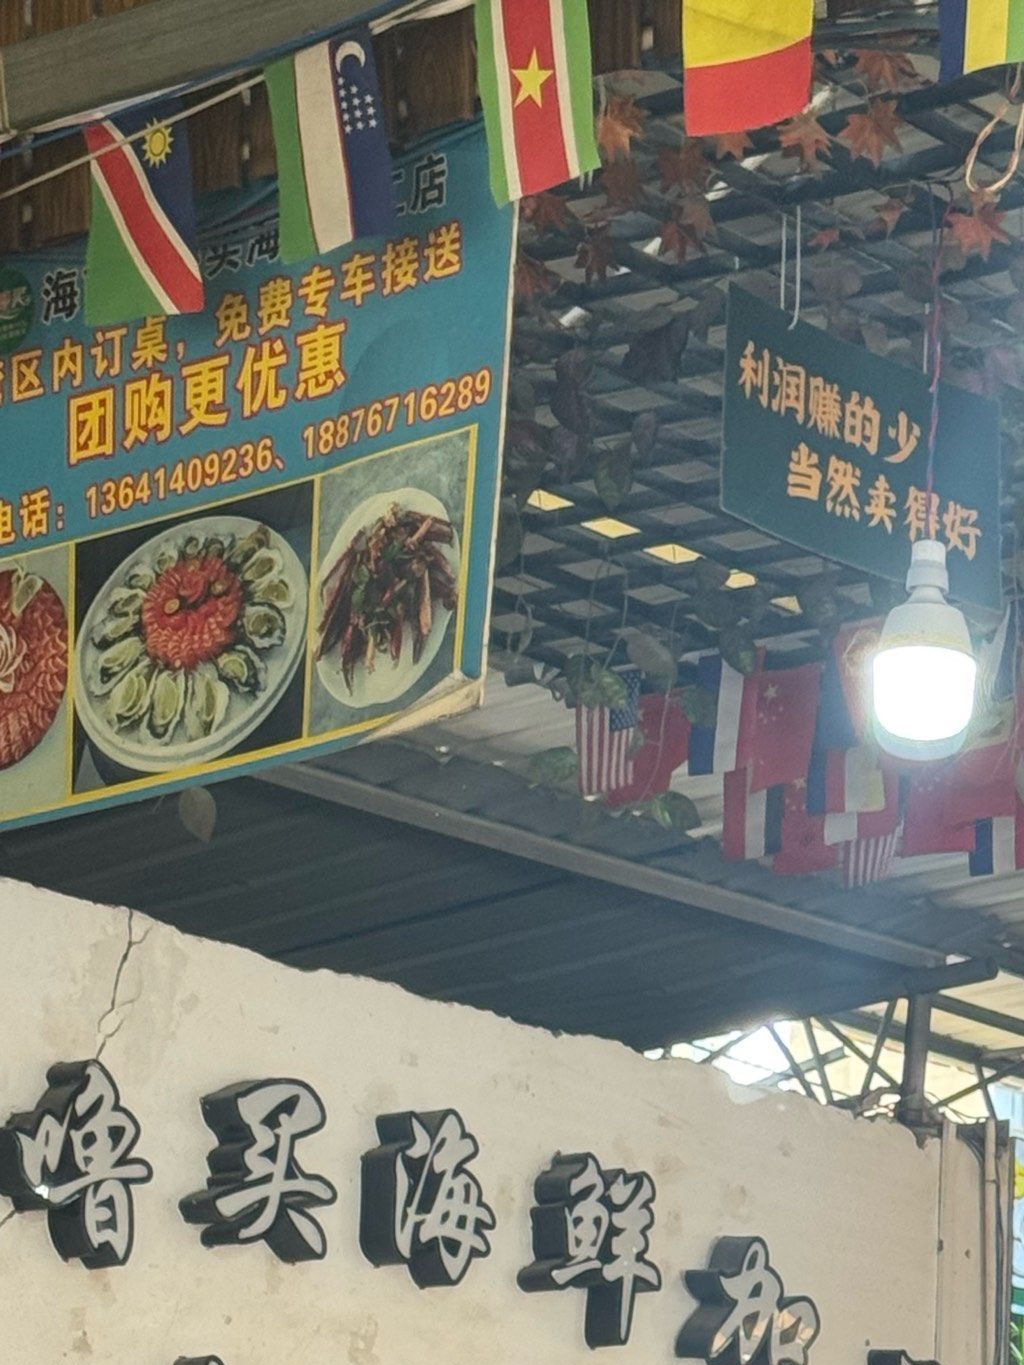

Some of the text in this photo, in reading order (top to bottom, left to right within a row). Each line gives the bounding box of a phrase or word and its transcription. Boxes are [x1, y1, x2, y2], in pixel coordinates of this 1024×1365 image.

[0, 221, 464, 402] 区内订桌，免费专车接送
[66, 321, 349, 468] 团购更优惠
[738, 340, 921, 463] 利润赚的少
[786, 442, 981, 560] 当然卖得好
